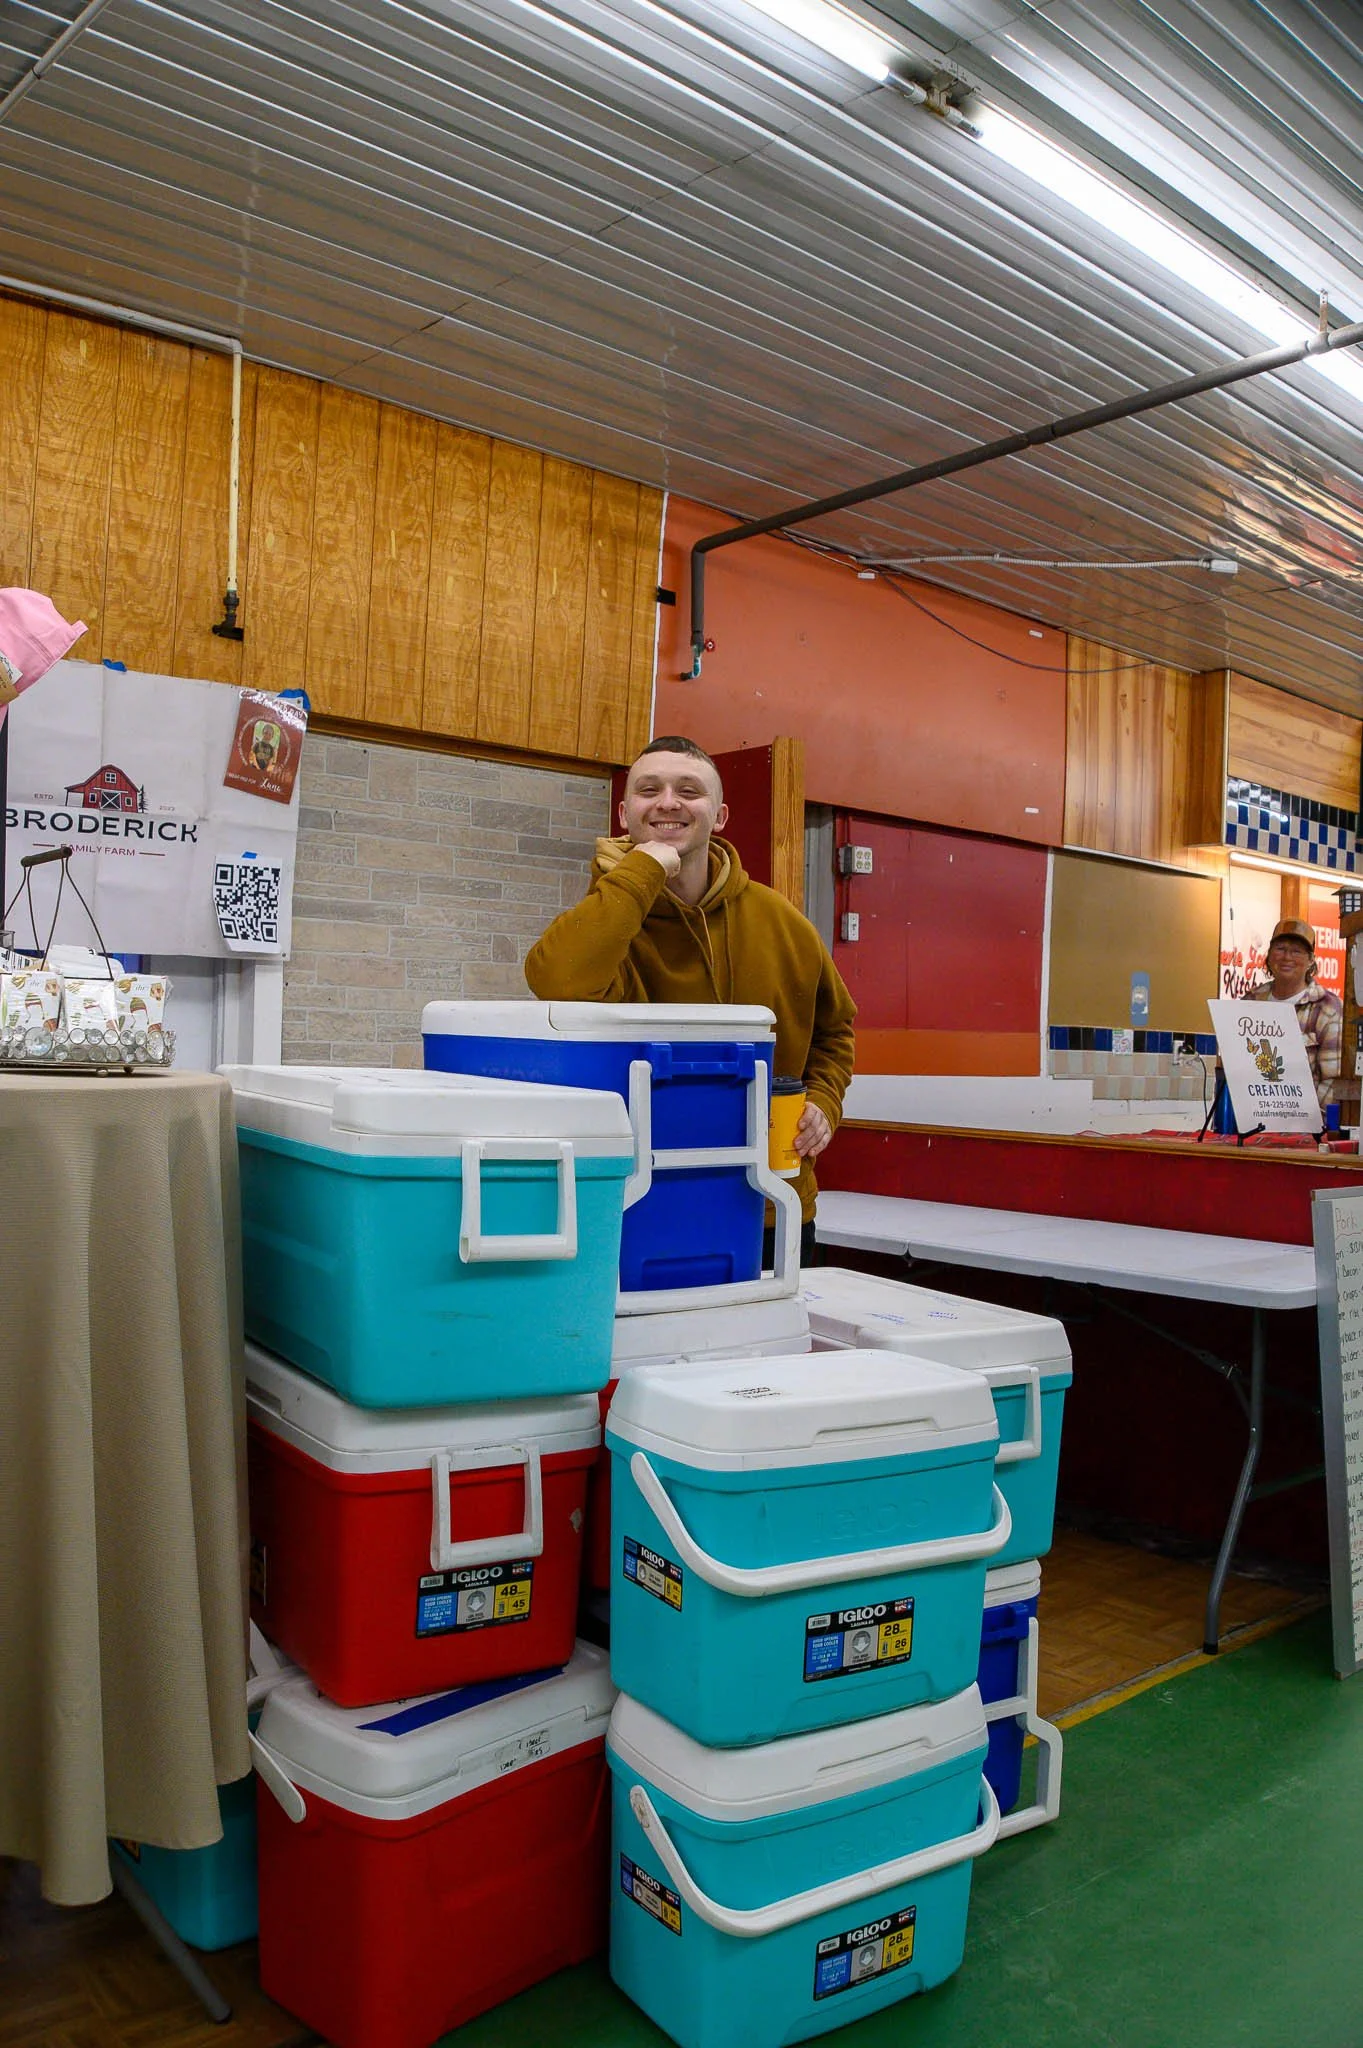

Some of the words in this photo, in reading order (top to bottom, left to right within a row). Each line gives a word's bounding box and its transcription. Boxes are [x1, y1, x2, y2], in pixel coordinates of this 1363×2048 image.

[5, 808, 198, 843] BRODERICK
[104, 847, 136, 857] FARM
[1238, 1016, 1285, 1038] Rita's
[1248, 1084, 1303, 1097] CREATIONS
[1258, 1100, 1300, 1109] 574-229-1304
[1335, 1207, 1357, 1233] Pork
[640, 1546, 665, 1568] IGLOO
[452, 1566, 503, 1584] IGLOO
[500, 1585, 519, 1597] 48
[512, 1600, 526, 1609] 45
[838, 1604, 887, 1625] IGLOO
[884, 1623, 900, 1637] 28
[895, 1638, 907, 1649] 26
[635, 1866, 661, 1891] IGLOO
[847, 1918, 892, 1945] IGLOO
[888, 1932, 903, 1947] 28
[898, 1944, 909, 1956] 26
